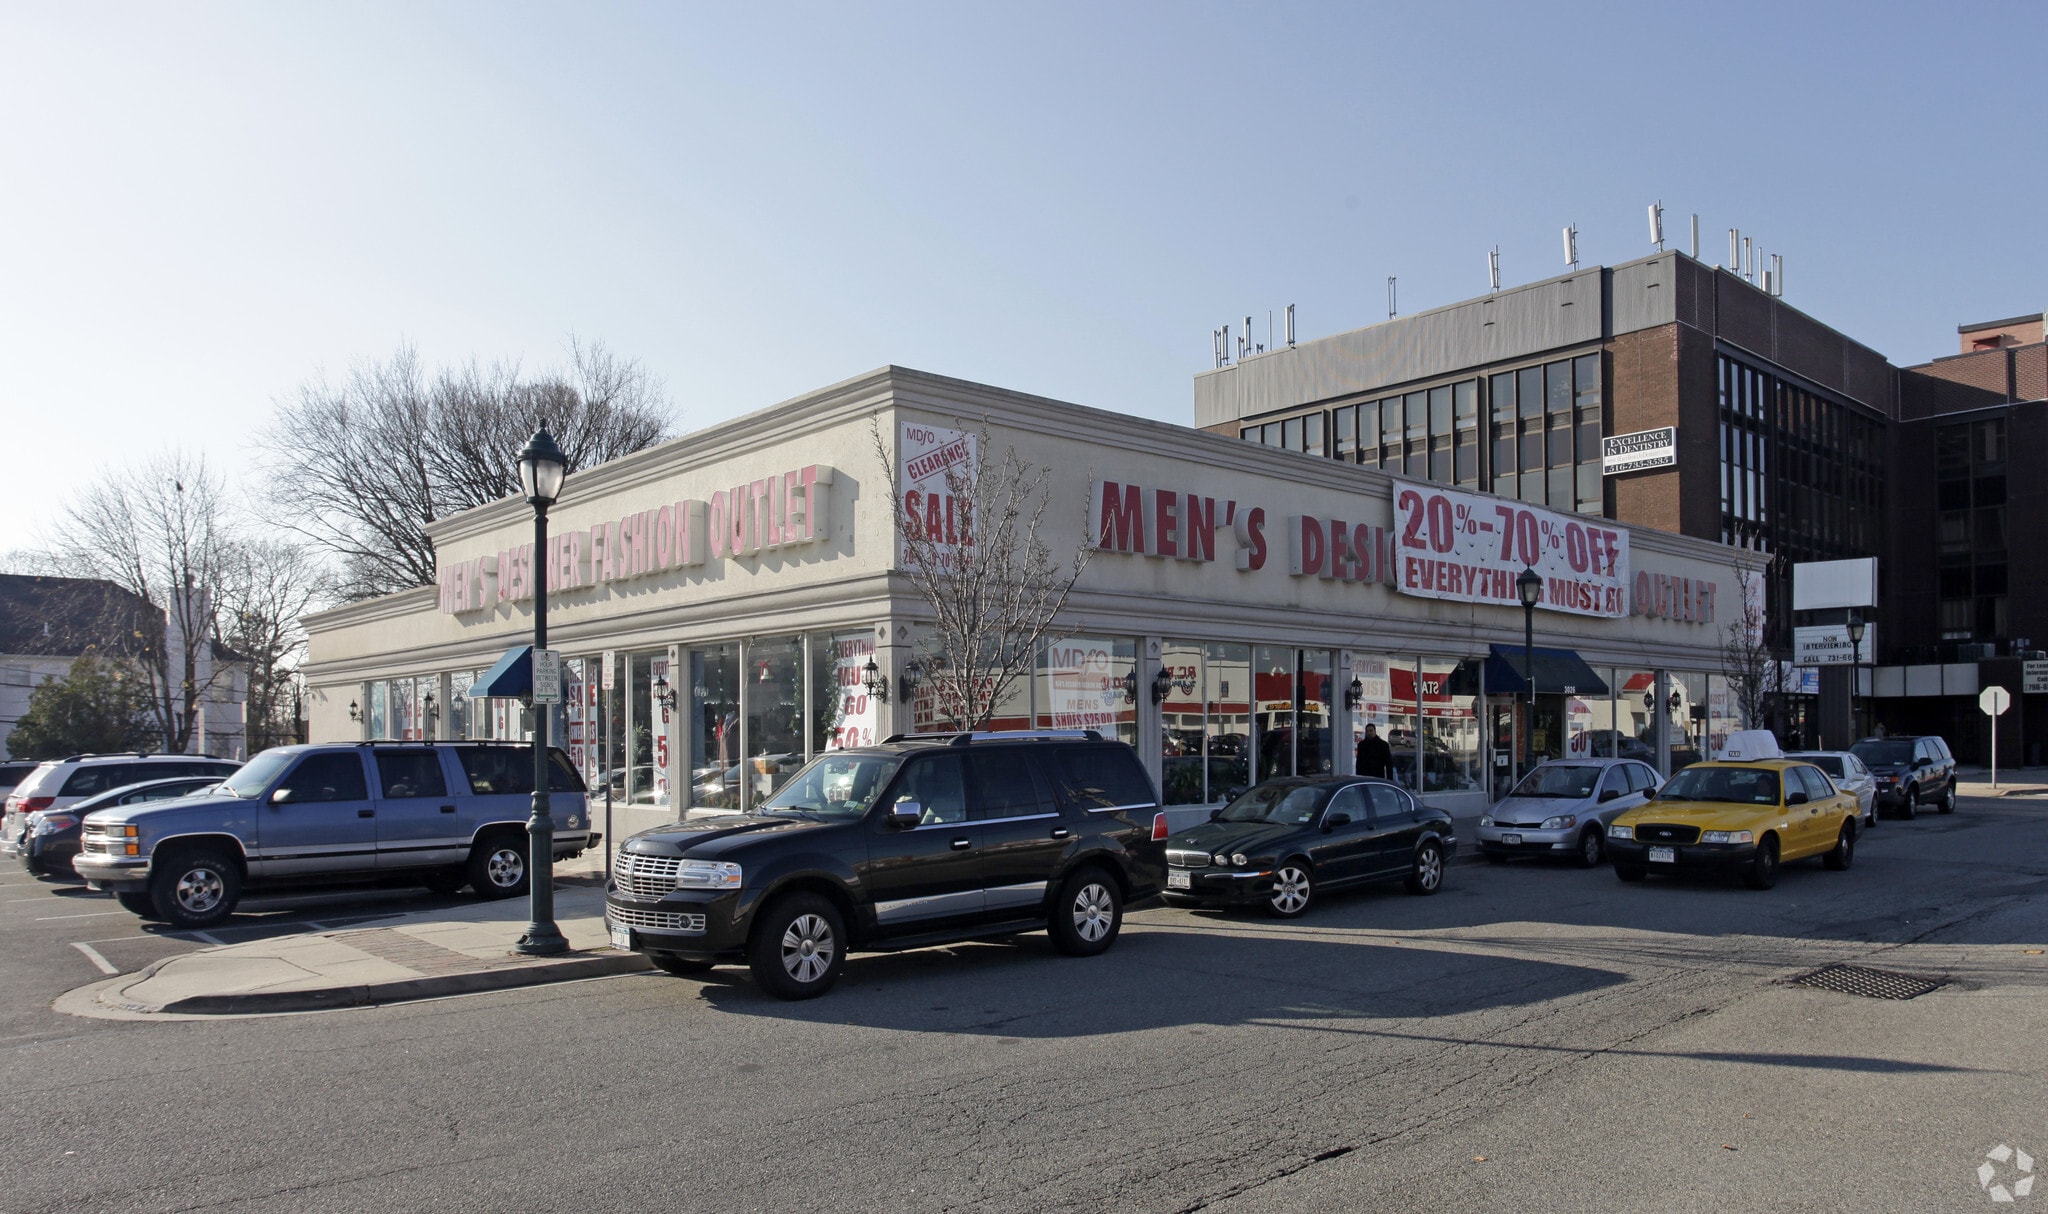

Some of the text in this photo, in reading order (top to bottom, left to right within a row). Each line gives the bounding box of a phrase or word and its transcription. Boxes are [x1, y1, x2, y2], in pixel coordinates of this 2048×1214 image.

[1607, 438, 1670, 456] IN DENTISTRY
[1610, 431, 1667, 447] EXCELLENCE
[904, 489, 974, 547] SALE
[440, 464, 817, 614] MEN'S DESINER FASHION OUTLET
[1100, 480, 1267, 571] MEN'S
[1636, 570, 1717, 623] OUTLET
[1565, 522, 1619, 578] OFF
[1548, 578, 1602, 612] MUST
[1606, 587, 1624, 614] GO
[1803, 655, 1820, 663] CALL
[1564, 685, 1576, 694] 3026
[845, 695, 867, 715] GO
[1067, 698, 1100, 710] MENS
[1055, 711, 1082, 729] SHOES
